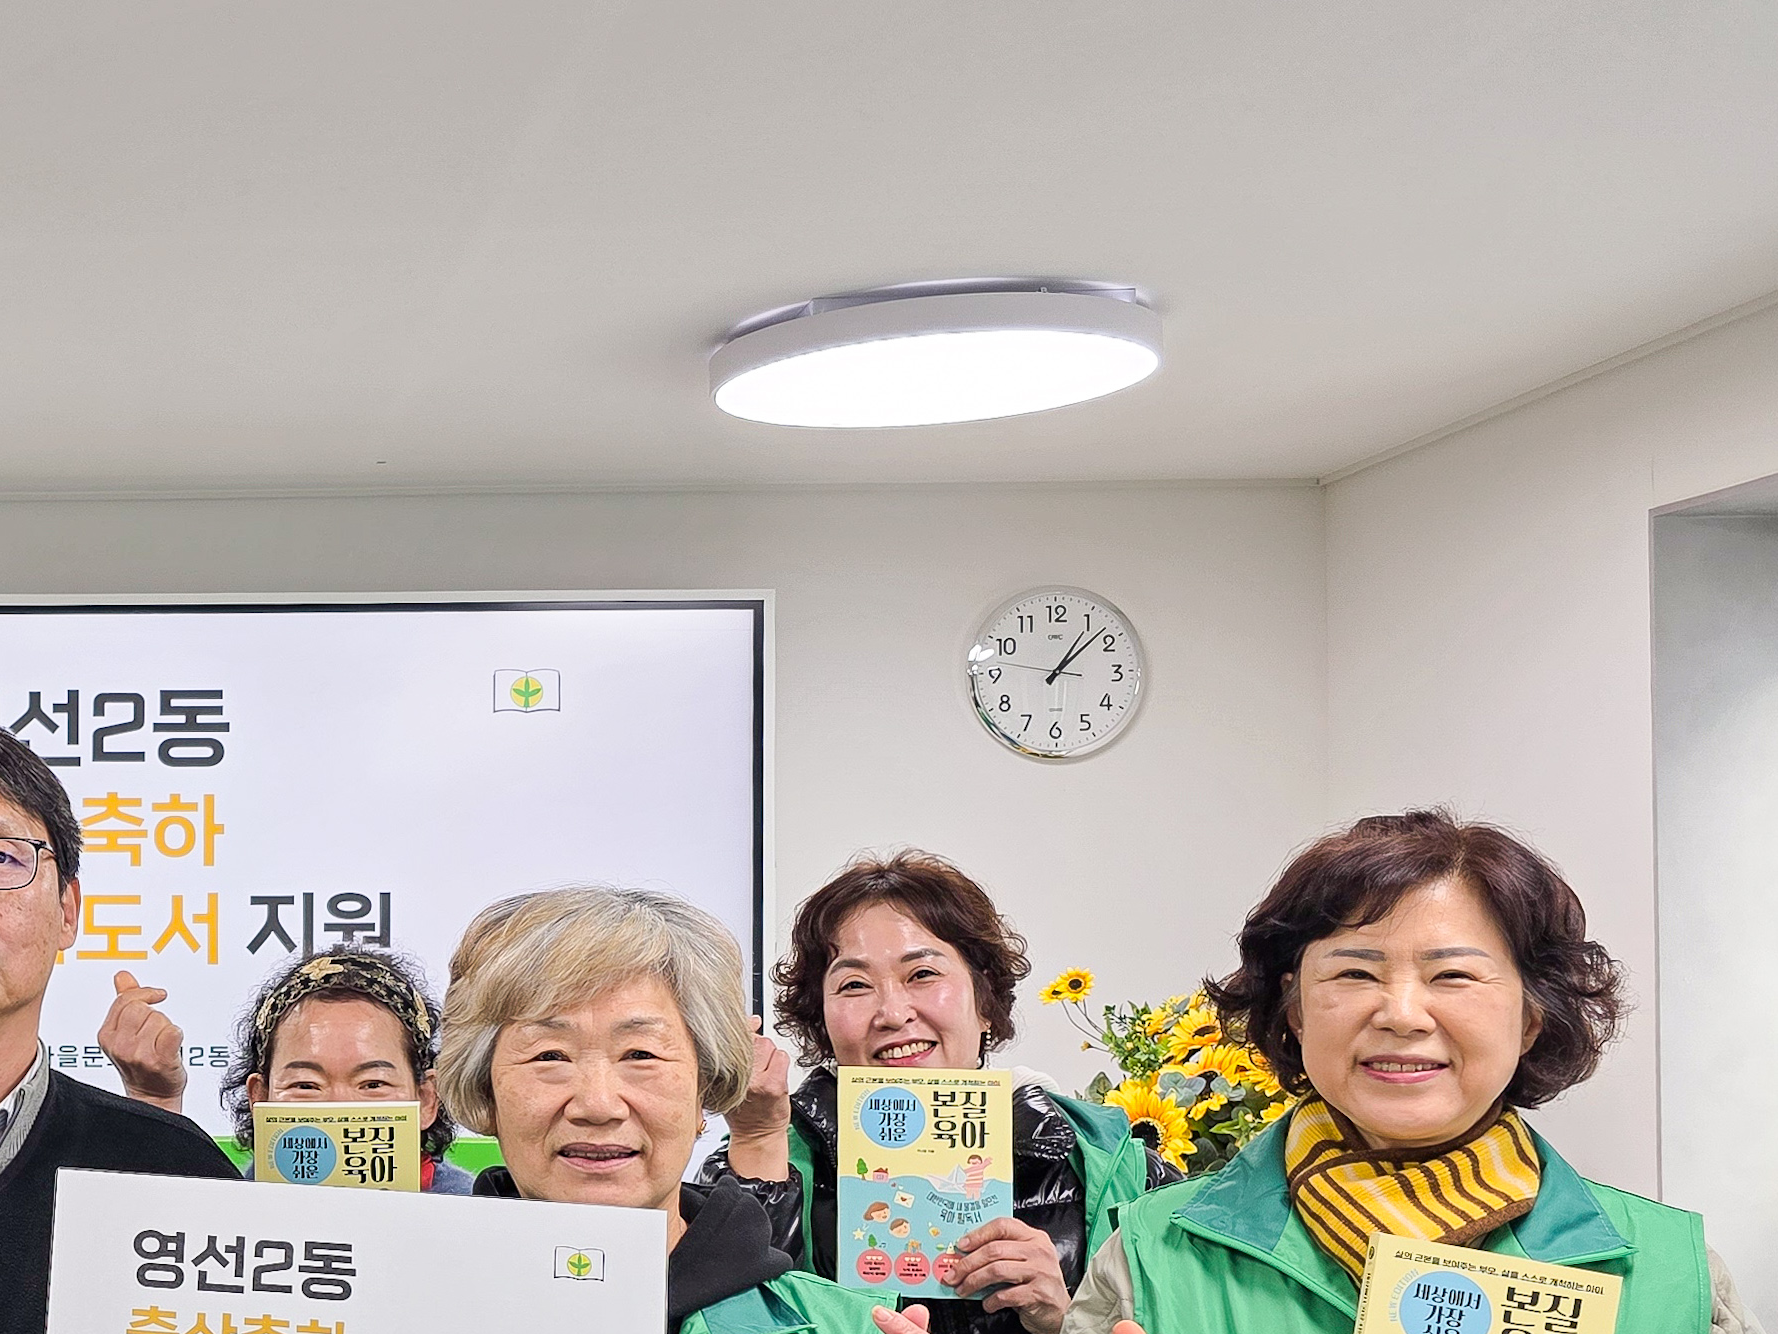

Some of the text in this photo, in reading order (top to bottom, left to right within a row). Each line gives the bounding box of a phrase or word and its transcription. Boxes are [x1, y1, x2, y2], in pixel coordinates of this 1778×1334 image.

[1046, 605, 1067, 623] 12
[1084, 614, 1090, 631] 1
[1017, 616, 1033, 633] 11
[996, 638, 1016, 655] 10
[1103, 635, 1115, 652] 2
[989, 667, 1002, 684] 9
[1112, 664, 1122, 682] 3
[999, 695, 1011, 711] 8
[1100, 693, 1113, 711] 4
[1021, 715, 1032, 731] 7
[1050, 722, 1061, 739] 6
[1080, 714, 1091, 731] 5
[81, 792, 224, 866] 축하
[76, 892, 391, 965] 도서 지원
[868, 1099, 916, 1111] 세상에서
[930, 1090, 986, 1119] 본질
[878, 1112, 907, 1127] 가장
[341, 1126, 394, 1154] 본질
[878, 1127, 906, 1141] 쉬운
[931, 1120, 989, 1148] 육아
[282, 1137, 327, 1149] 세상에서
[292, 1150, 319, 1164] 가장
[292, 1165, 319, 1178] 쉬운
[342, 1155, 397, 1183] 육아
[133, 1229, 358, 1300] 영선2동
[1413, 1283, 1482, 1310] 세상에서
[1424, 1303, 1467, 1329] 가장
[1501, 1285, 1582, 1334] 본질
